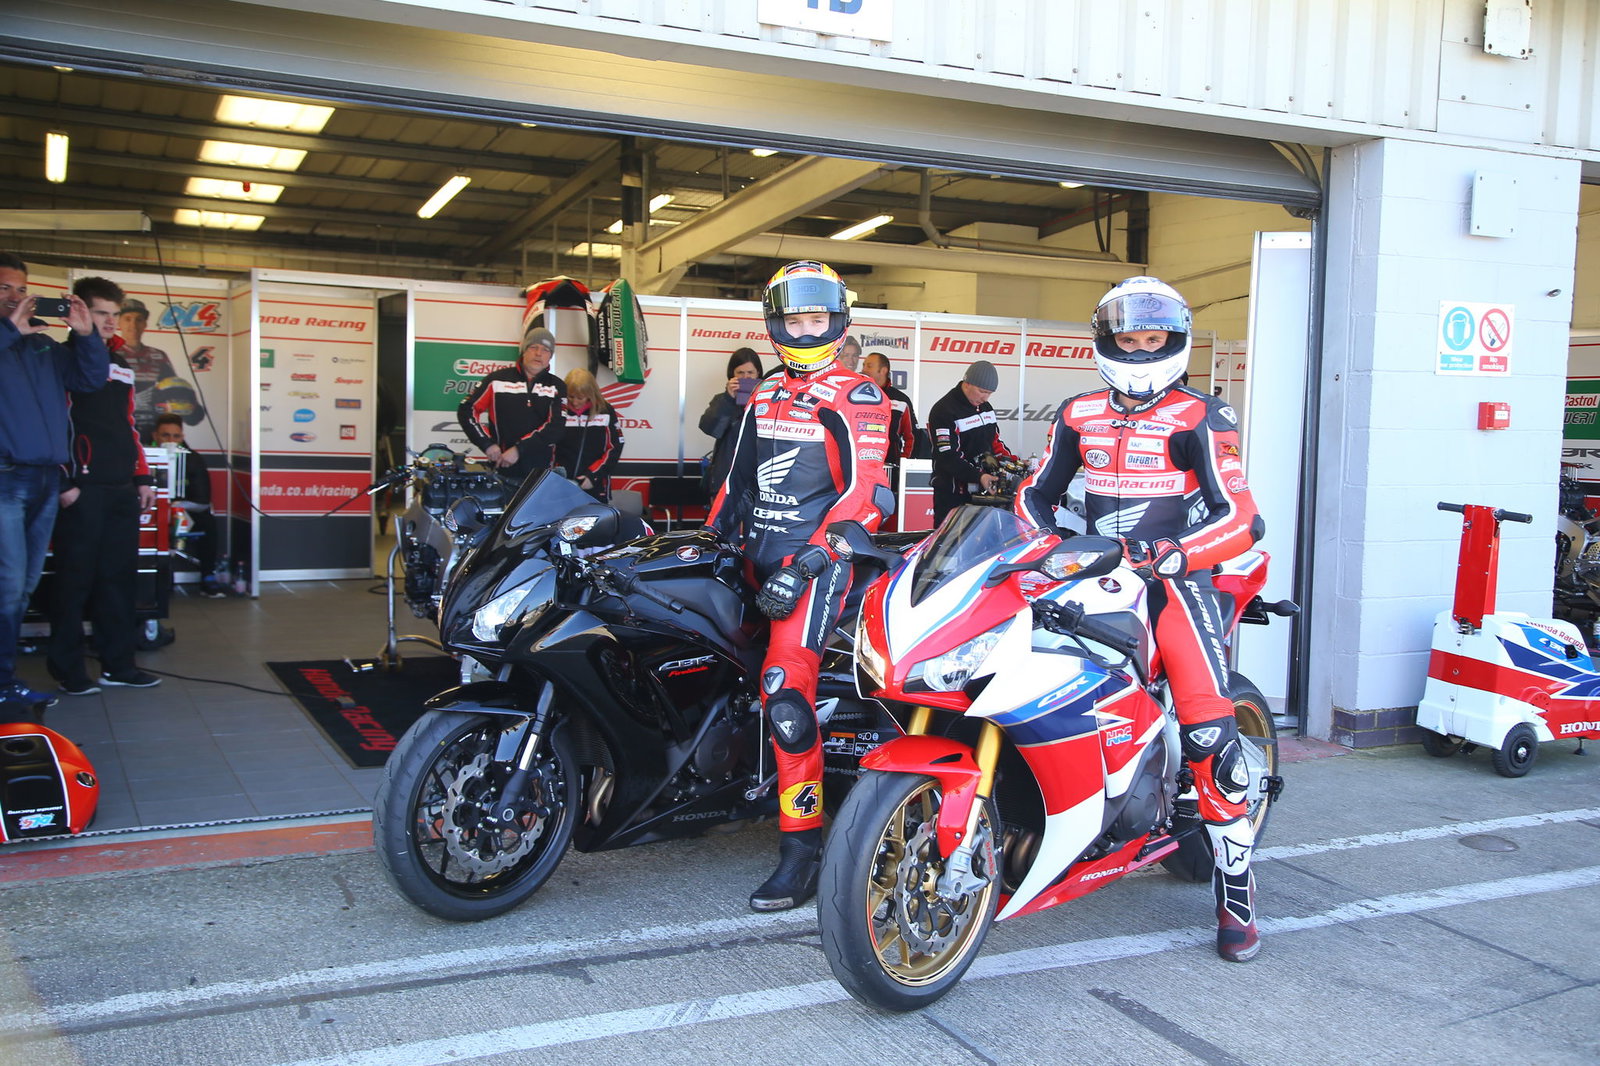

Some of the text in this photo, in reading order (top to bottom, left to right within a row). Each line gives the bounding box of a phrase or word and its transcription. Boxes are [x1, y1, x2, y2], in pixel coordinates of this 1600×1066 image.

[305, 317, 366, 332] Racing
[691, 328, 772, 341] Honda Rac
[930, 336, 1096, 361] Honda Racin
[774, 423, 816, 437] Racing
[1118, 479, 1176, 490] Racing
[759, 490, 800, 506] ONDA
[824, 562, 842, 606] Racing
[1184, 580, 1216, 634] Racing
[658, 654, 718, 671] CBR
[298, 667, 352, 702] Hond
[1037, 675, 1089, 709] CBR
[792, 782, 819, 817] 4
[672, 809, 728, 823] HONDA
[1079, 865, 1125, 882] HONDA
